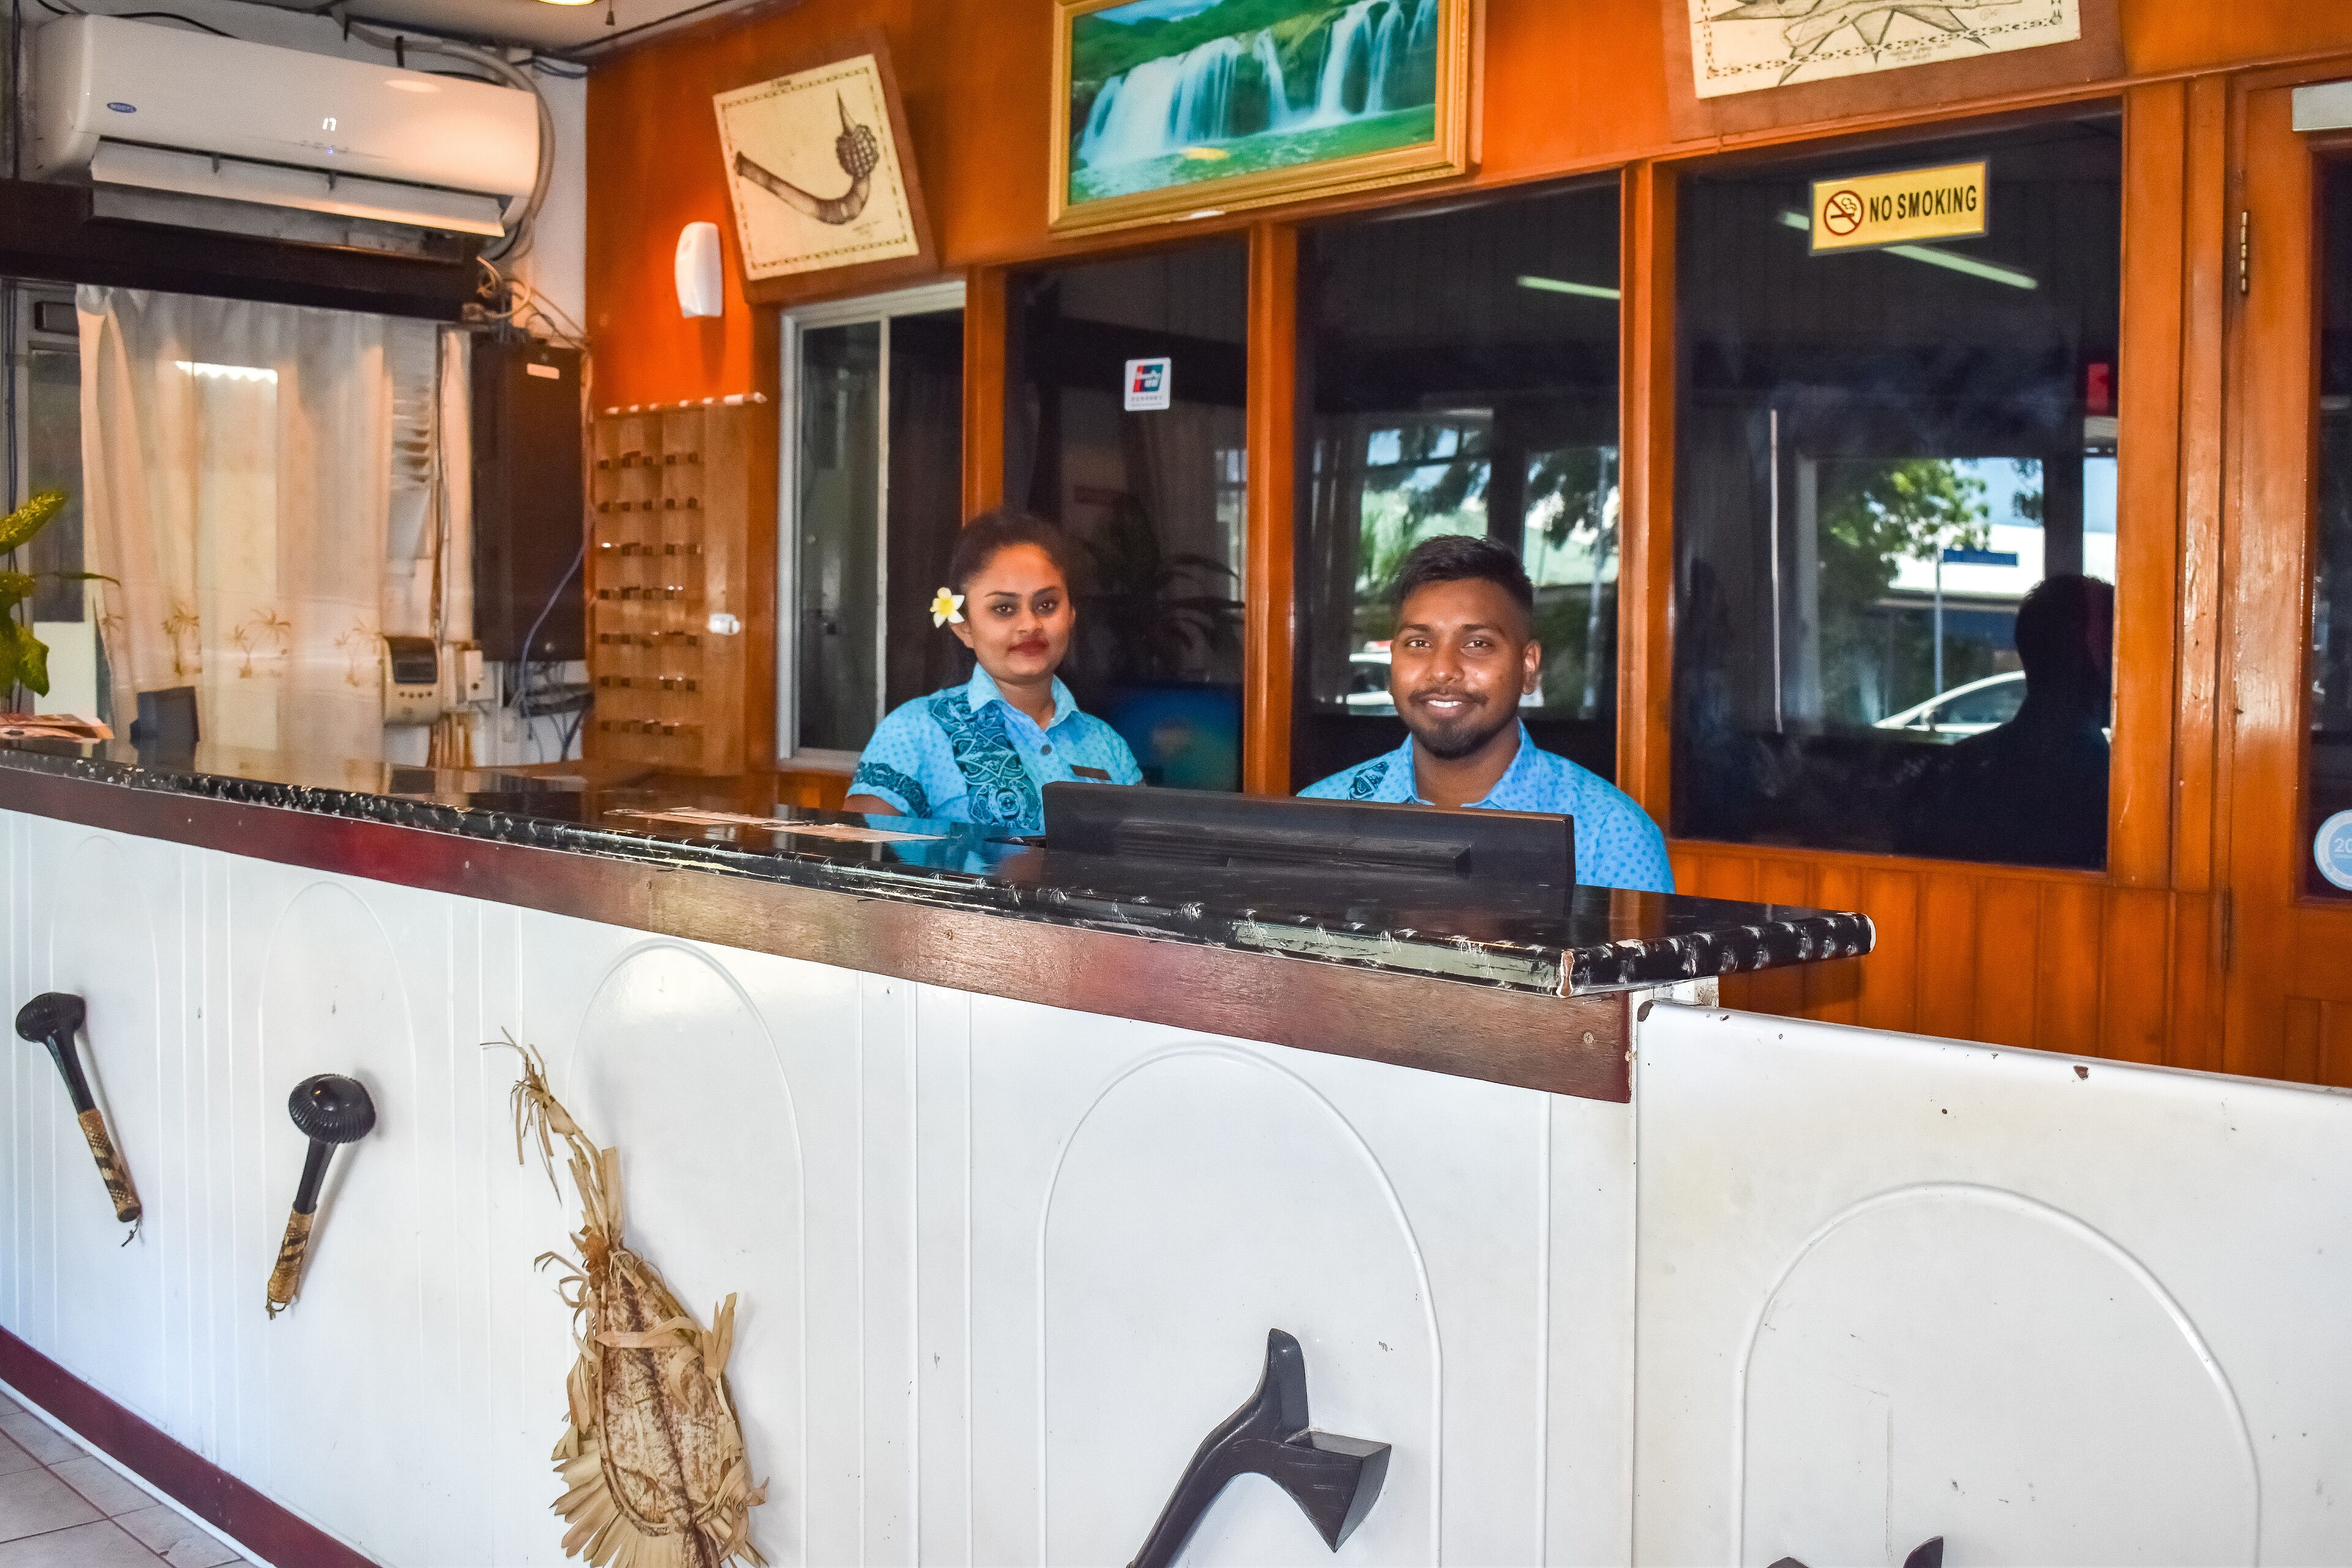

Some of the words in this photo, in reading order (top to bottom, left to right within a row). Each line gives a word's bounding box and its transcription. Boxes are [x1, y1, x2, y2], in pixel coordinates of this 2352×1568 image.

[323, 117, 336, 132] 17
[1870, 195, 1891, 222] NO
[1897, 185, 1977, 219] SMOKING
